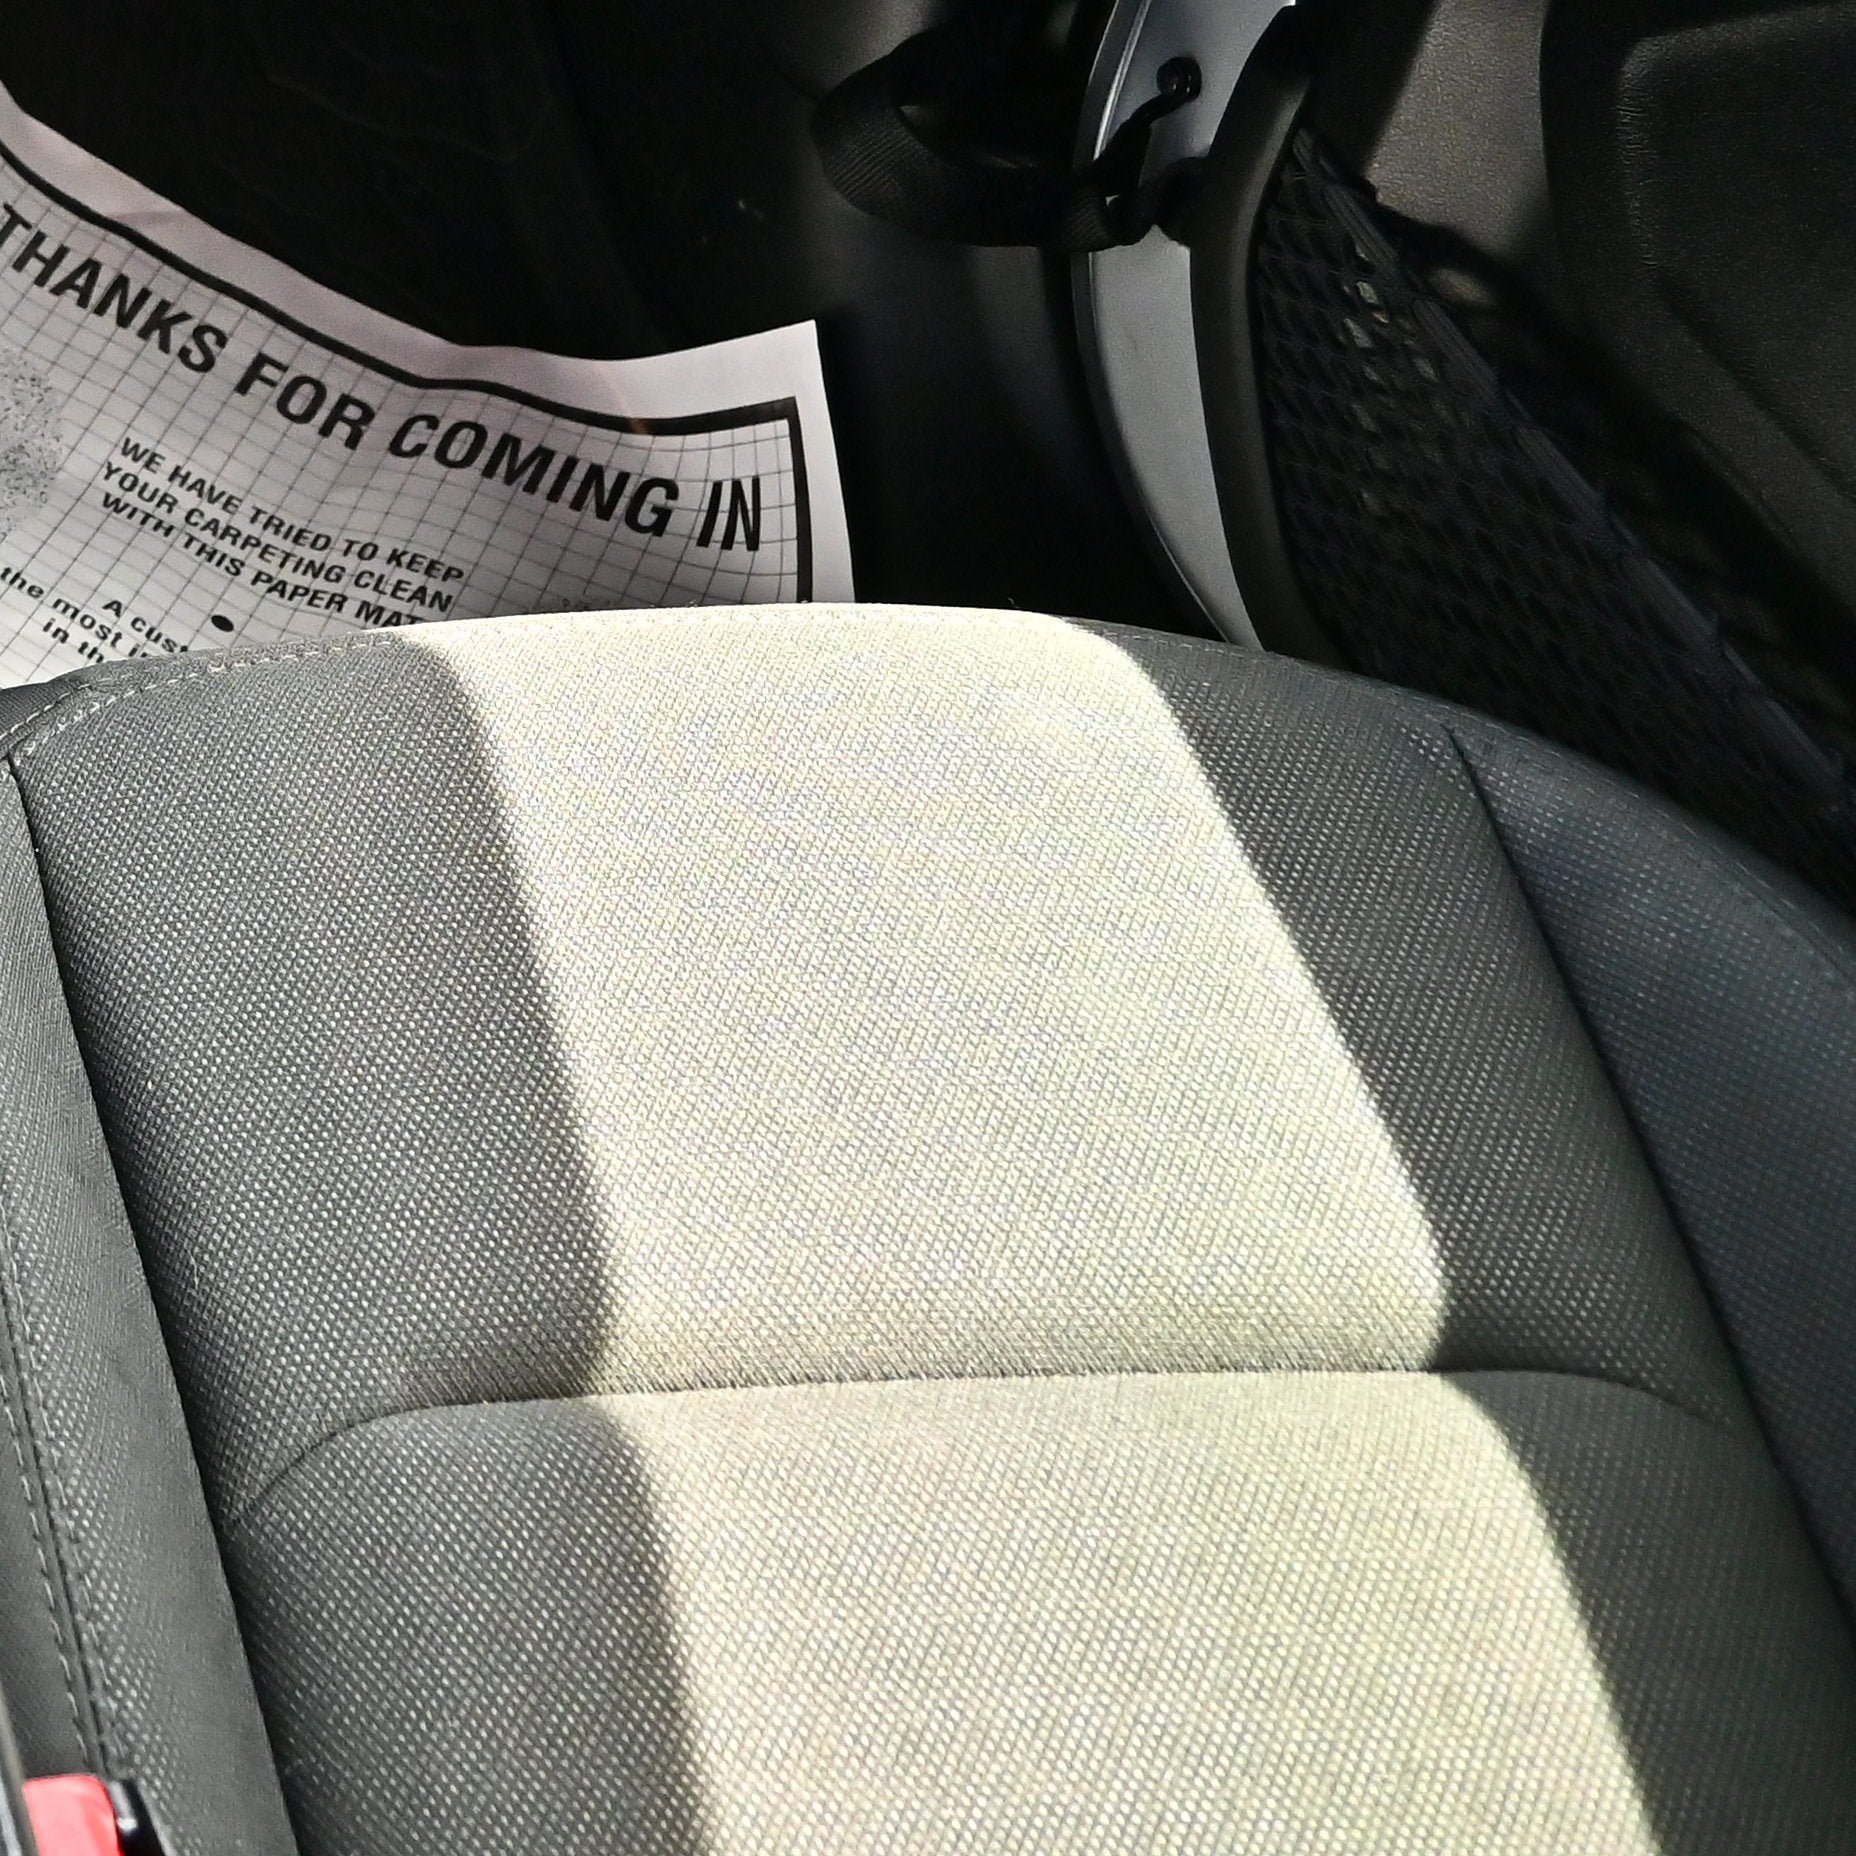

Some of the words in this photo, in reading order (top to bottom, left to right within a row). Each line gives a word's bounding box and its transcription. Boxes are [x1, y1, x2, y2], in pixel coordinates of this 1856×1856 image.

[120, 436, 165, 474] WE
[168, 464, 244, 515] HAVE
[248, 505, 332, 552] TRIED
[343, 538, 380, 562] TO
[388, 549, 464, 582] KEEP
[234, 352, 376, 451] FOR
[387, 413, 679, 538] COMING
[696, 475, 761, 552] IN
[102, 493, 174, 539] WITH
[184, 532, 245, 577] THIS
[250, 569, 348, 613] PAPER
[103, 461, 179, 515] YOUR
[184, 507, 346, 583] CARPETING
[353, 570, 454, 613] CLEAN
[0, 566, 44, 599] the
[52, 597, 123, 648] most
[42, 618, 70, 644] in
[102, 600, 123, 618] A
